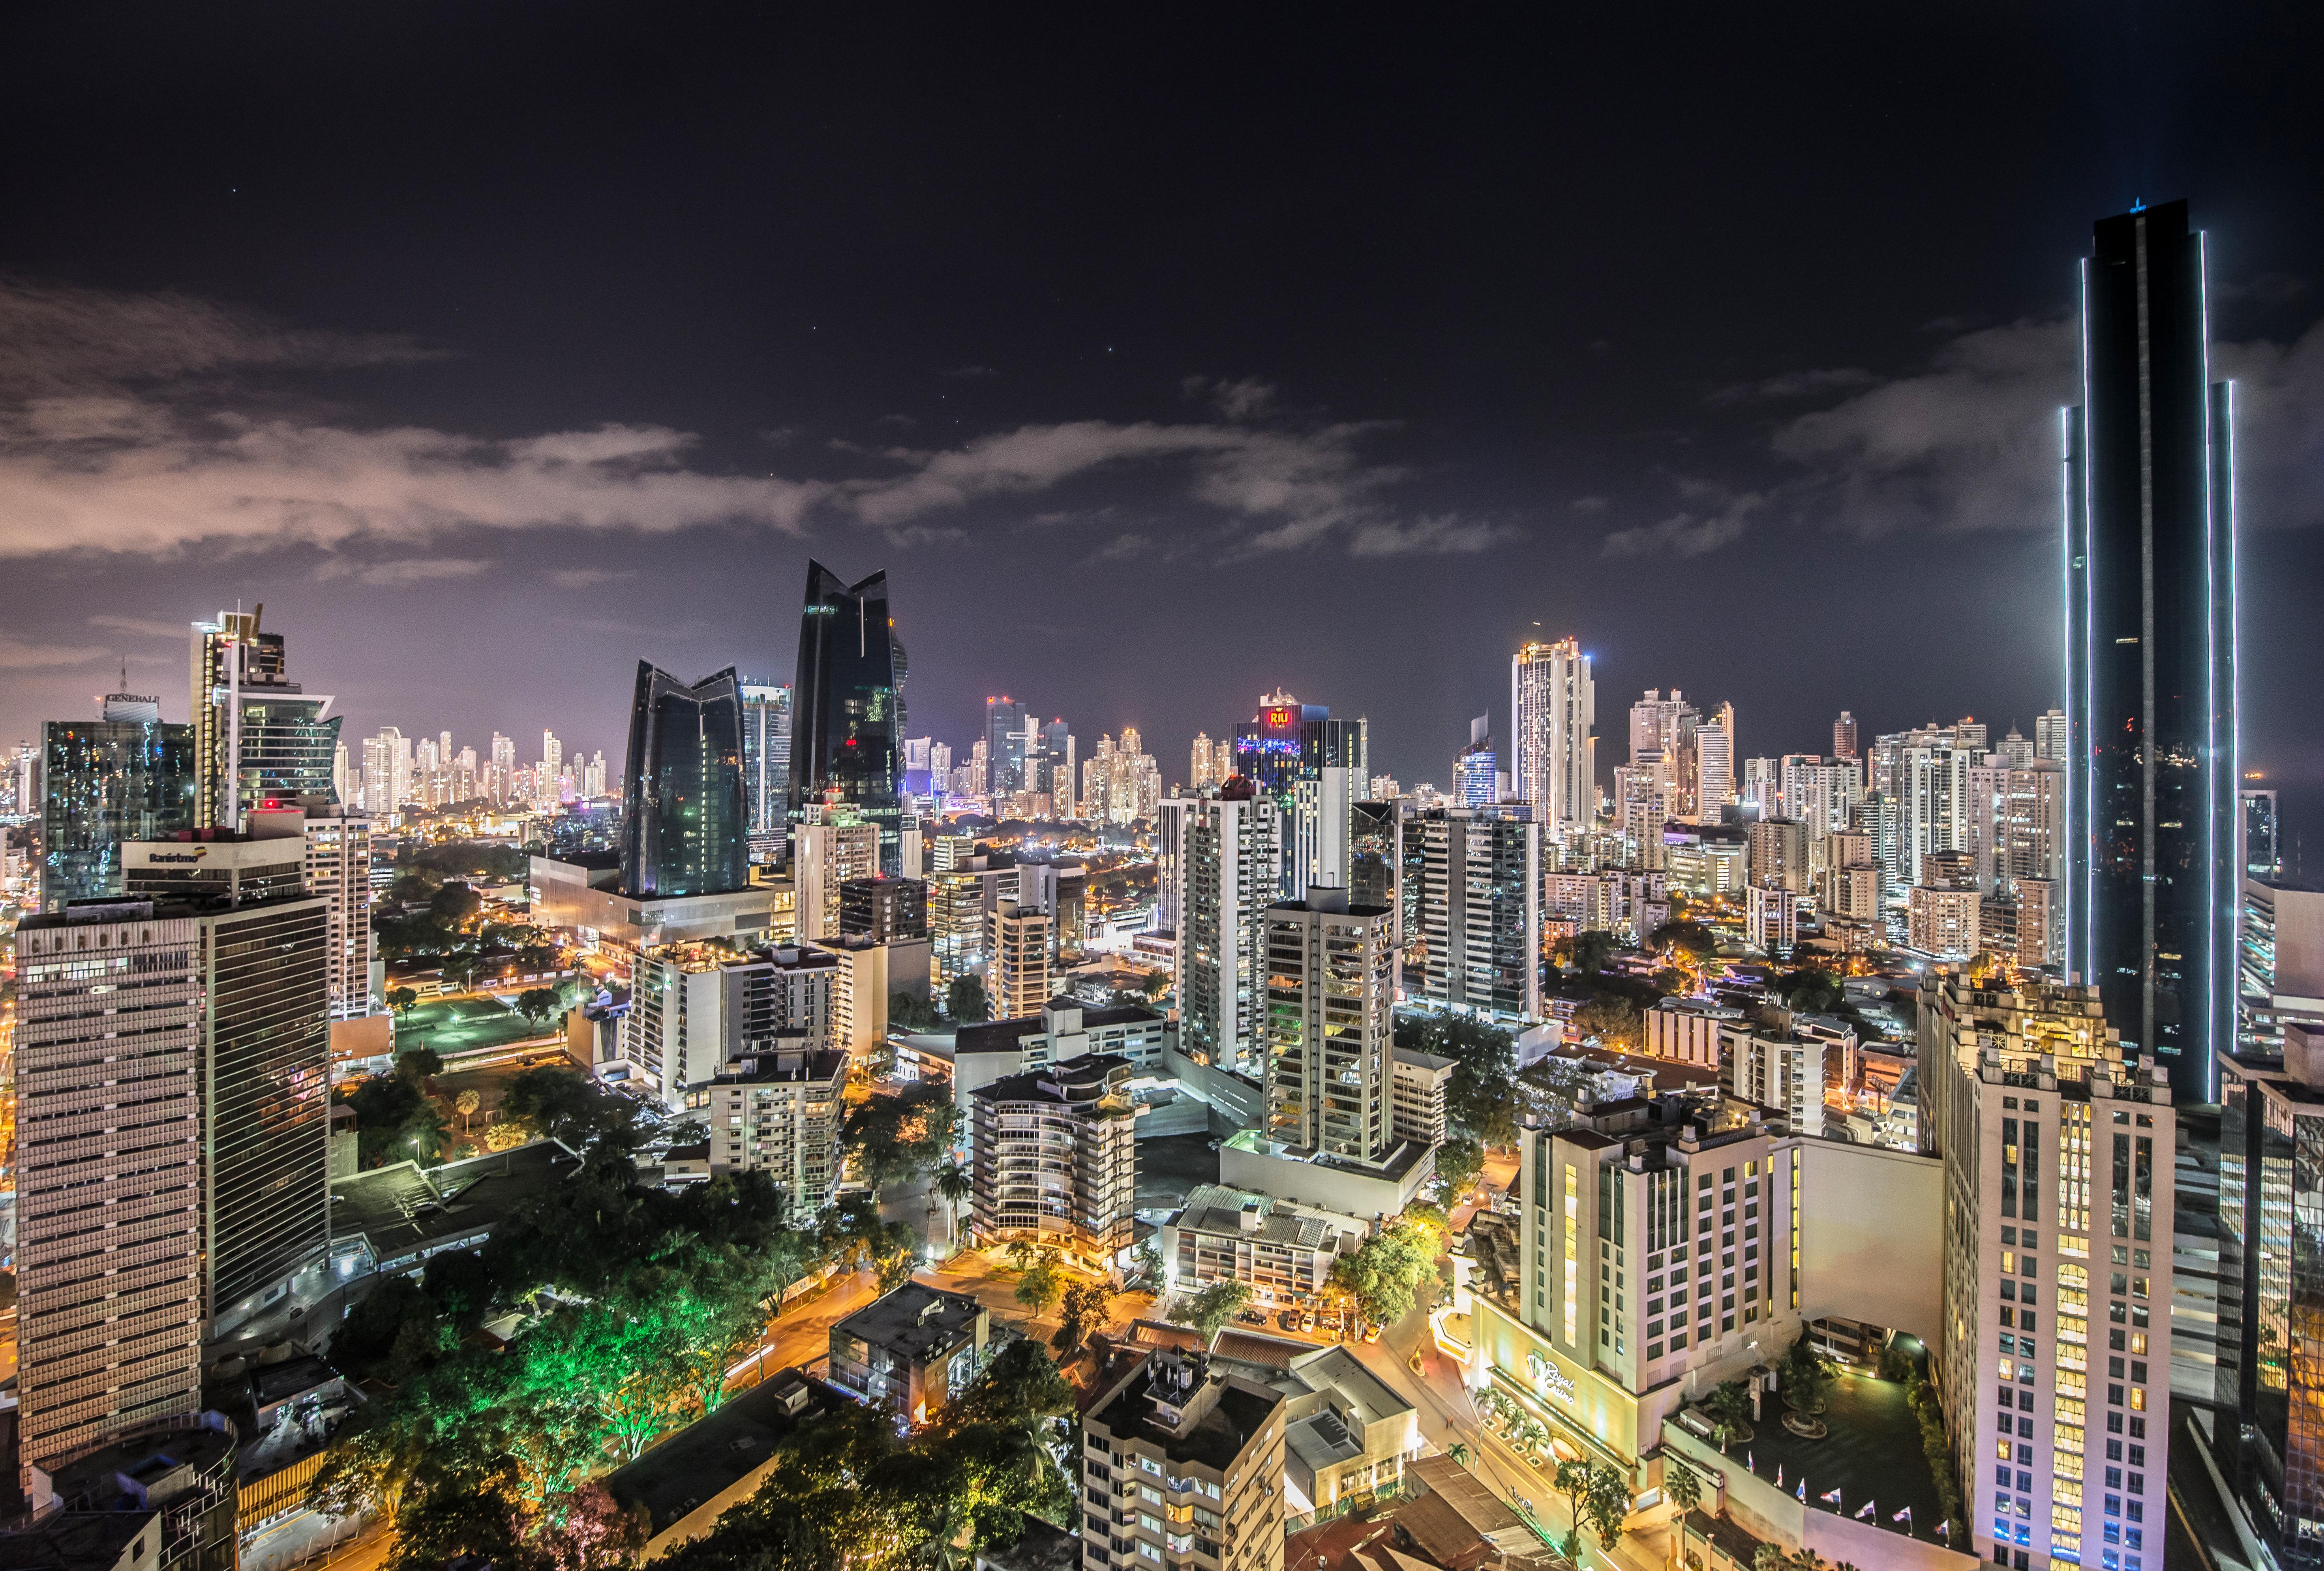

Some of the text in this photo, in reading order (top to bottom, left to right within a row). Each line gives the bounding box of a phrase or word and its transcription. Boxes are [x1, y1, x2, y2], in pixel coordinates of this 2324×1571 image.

[1271, 712, 1288, 723] RIU
[150, 853, 198, 863] Banistmo
[1544, 1361, 1575, 1390] Royal
[1545, 1378, 1574, 1405] Casino
